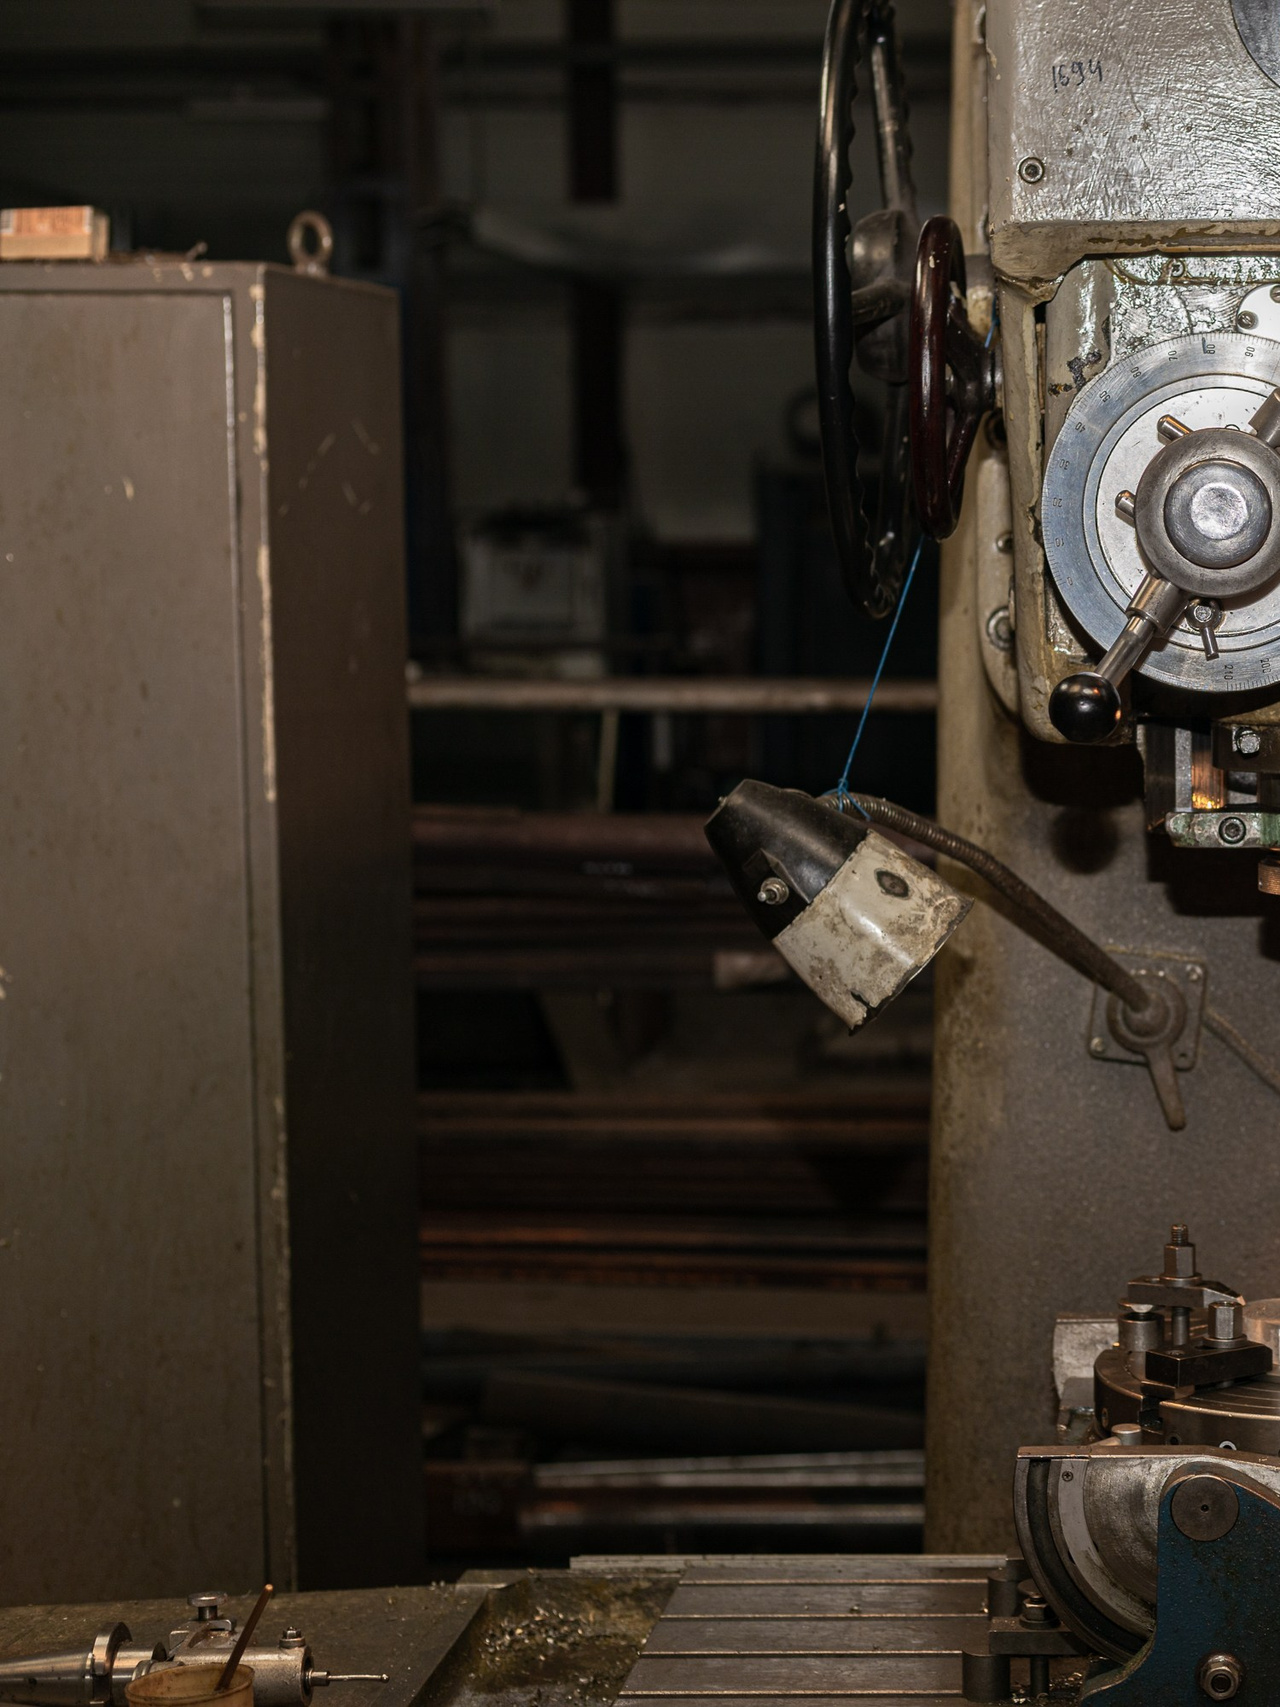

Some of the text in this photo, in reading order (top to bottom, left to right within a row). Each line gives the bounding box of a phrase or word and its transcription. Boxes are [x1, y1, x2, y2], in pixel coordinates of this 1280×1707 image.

[1167, 350, 1178, 361] 70
[1244, 346, 1255, 358] 90
[1099, 390, 1111, 402] 50
[1074, 421, 1086, 433] 40
[1223, 664, 1234, 681] 210
